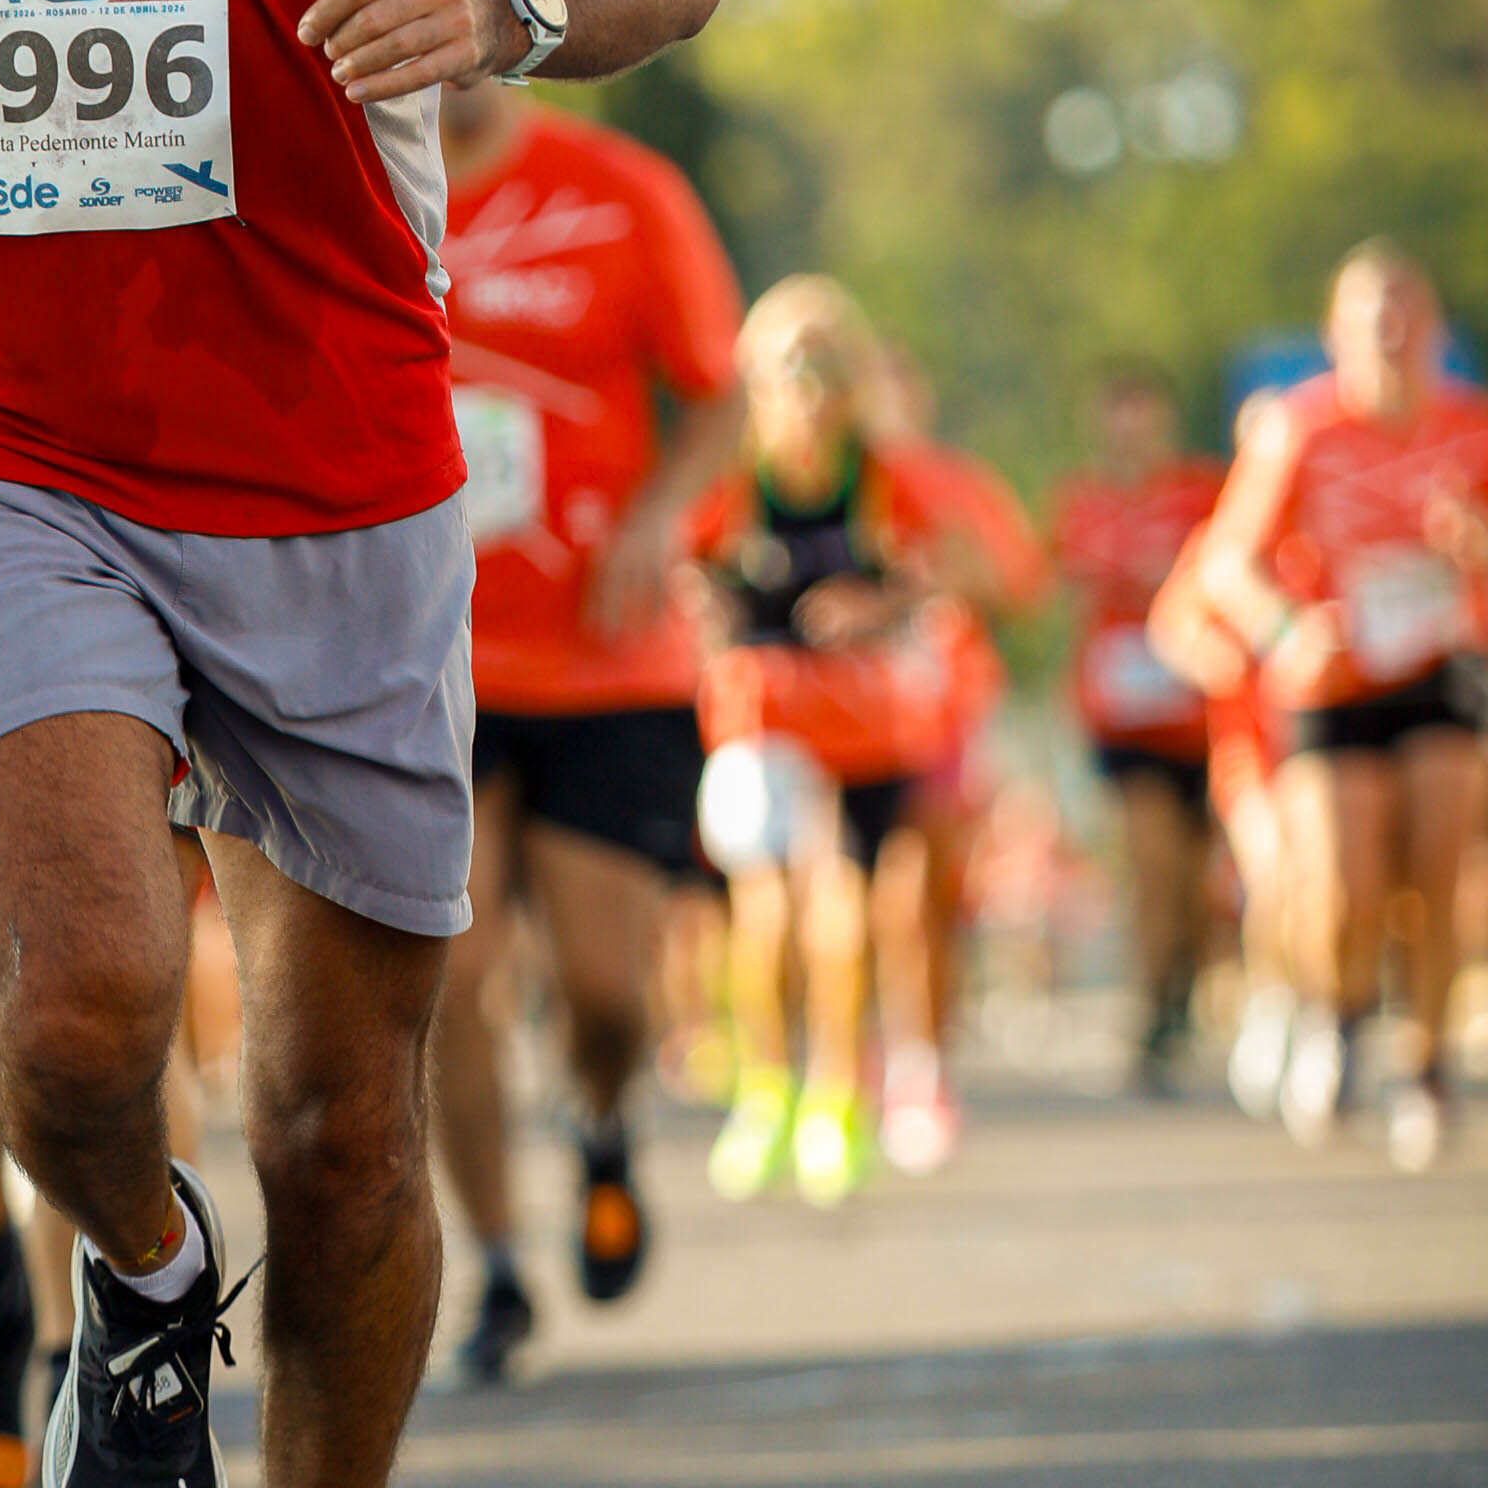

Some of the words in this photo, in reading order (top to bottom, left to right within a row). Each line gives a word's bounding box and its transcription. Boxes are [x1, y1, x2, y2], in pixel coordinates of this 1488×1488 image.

[13, 8, 35, 18] 2026
[45, 8, 88, 17] ROSARIO
[99, 7, 110, 16] 12
[113, 6, 126, 15] DE
[129, 5, 158, 15] ABRIL
[19, 133, 119, 152] Pedemonte
[124, 129, 186, 150] Martín
[134, 185, 184, 198] POWER
